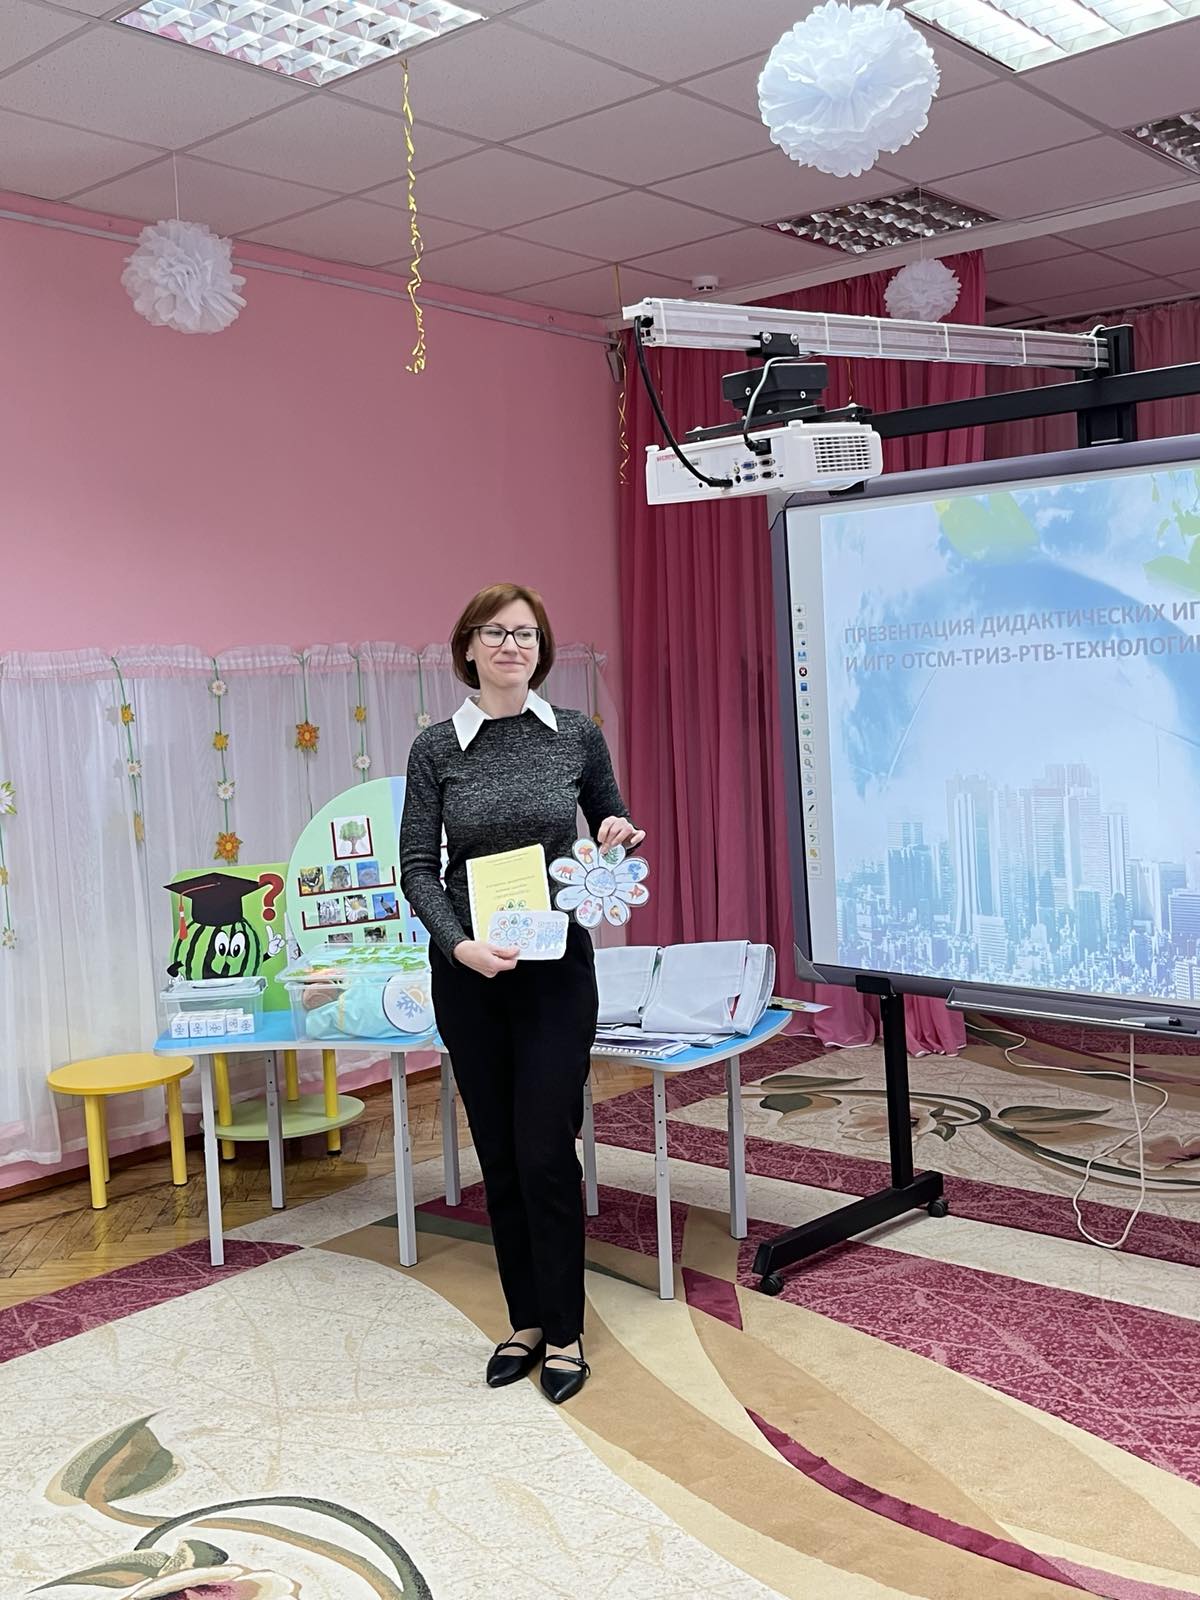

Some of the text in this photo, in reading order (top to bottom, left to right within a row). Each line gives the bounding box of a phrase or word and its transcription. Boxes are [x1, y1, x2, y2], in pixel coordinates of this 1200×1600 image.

[844, 618, 975, 644] ПРЕЗЕНТАЦИЯ
[980, 603, 1165, 638] ДИДАКТИЧЕСКИХ
[845, 635, 1200, 673] И ИГР ОТСМ-ТРИЗ-РТВ-ТЕХНОЛОГИ
